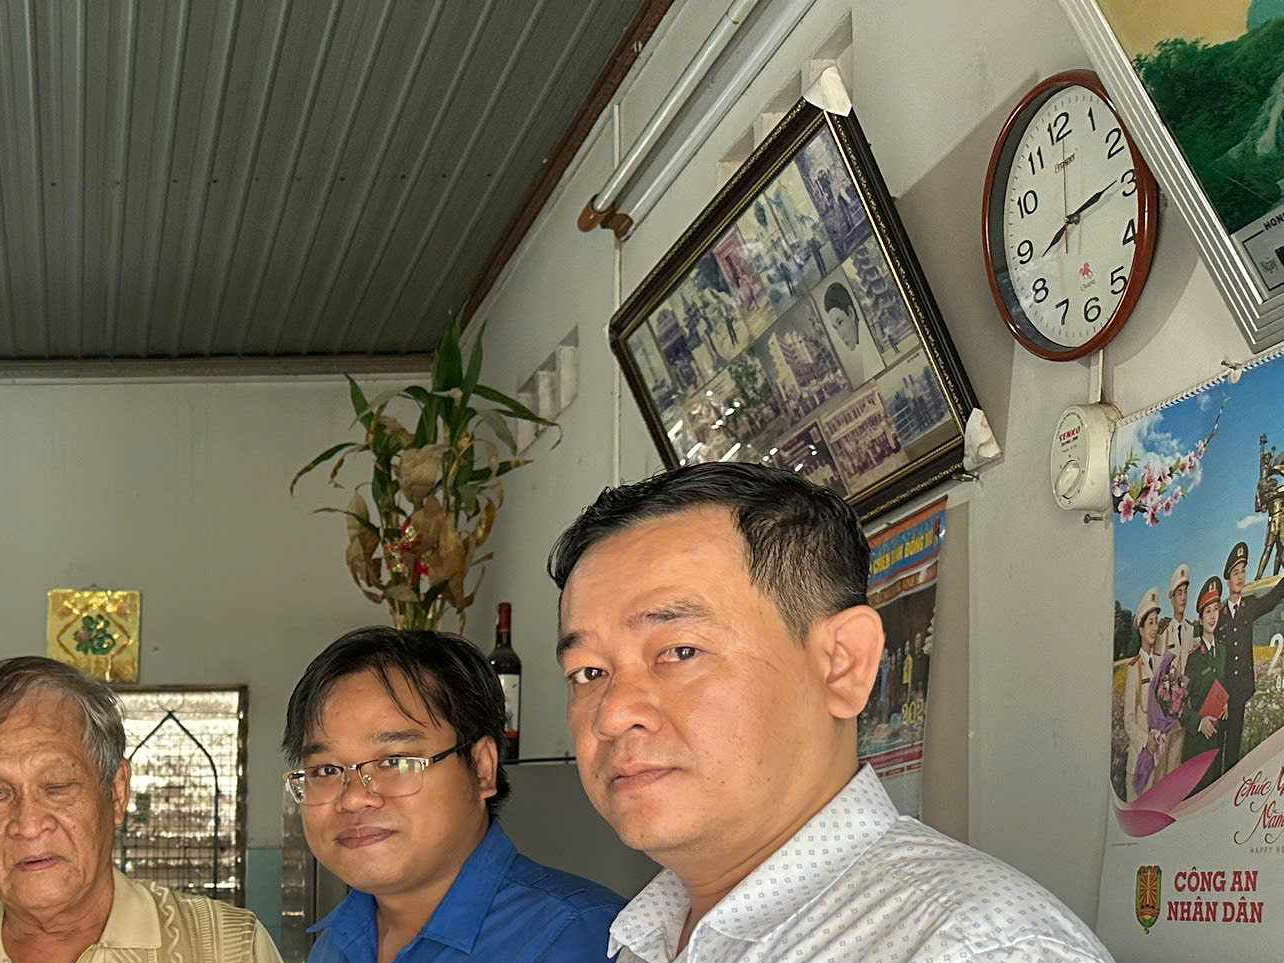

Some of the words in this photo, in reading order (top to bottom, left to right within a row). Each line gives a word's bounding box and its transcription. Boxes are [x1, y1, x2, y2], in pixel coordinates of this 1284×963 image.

[1047, 111, 1072, 146] 12
[1087, 107, 1096, 131] 1
[1105, 127, 1124, 160] 2
[1028, 146, 1044, 175] 11
[1120, 168, 1138, 197] 3
[1017, 189, 1038, 219] 10
[1122, 218, 1137, 246] 4
[1016, 240, 1034, 265] 9
[1032, 277, 1049, 304] 8
[1110, 265, 1127, 295] 5
[1054, 298, 1069, 325] 7
[1083, 296, 1102, 323] 6
[1174, 866, 1226, 892] CÔNG
[1230, 870, 1258, 892] AN
[1167, 896, 1218, 922] NHÂN
[1222, 896, 1264, 923] DÂN
